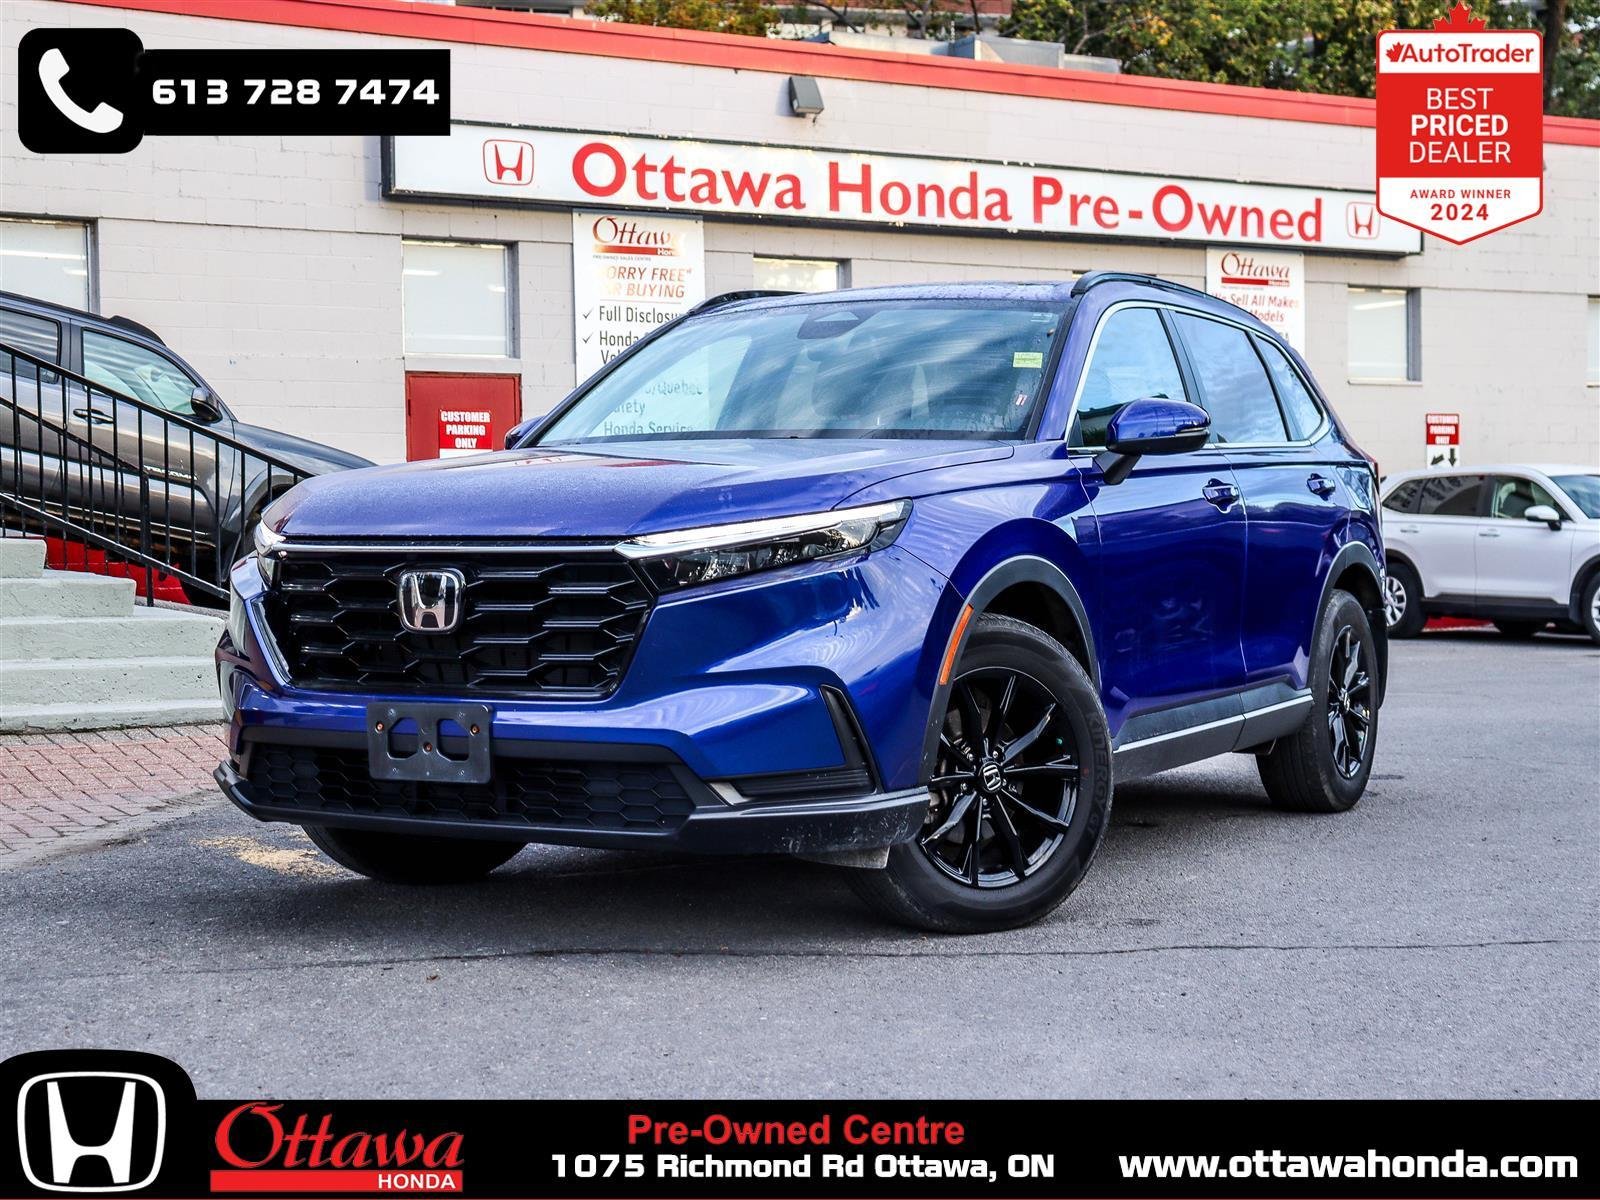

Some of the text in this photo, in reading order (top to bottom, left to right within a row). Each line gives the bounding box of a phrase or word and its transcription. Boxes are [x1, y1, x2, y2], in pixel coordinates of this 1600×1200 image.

[572, 142, 1323, 243] Ottawa Honda Pre-Owned
[592, 215, 672, 245] Ottaw
[607, 265, 647, 280] ORRY
[1221, 252, 1290, 278] Ottawa
[626, 283, 685, 298] BUYING
[600, 305, 621, 321] Full
[440, 411, 491, 422] CUSTOMER
[446, 425, 485, 436] PARKING
[603, 421, 644, 436] Honda
[455, 438, 477, 449] ONLY
